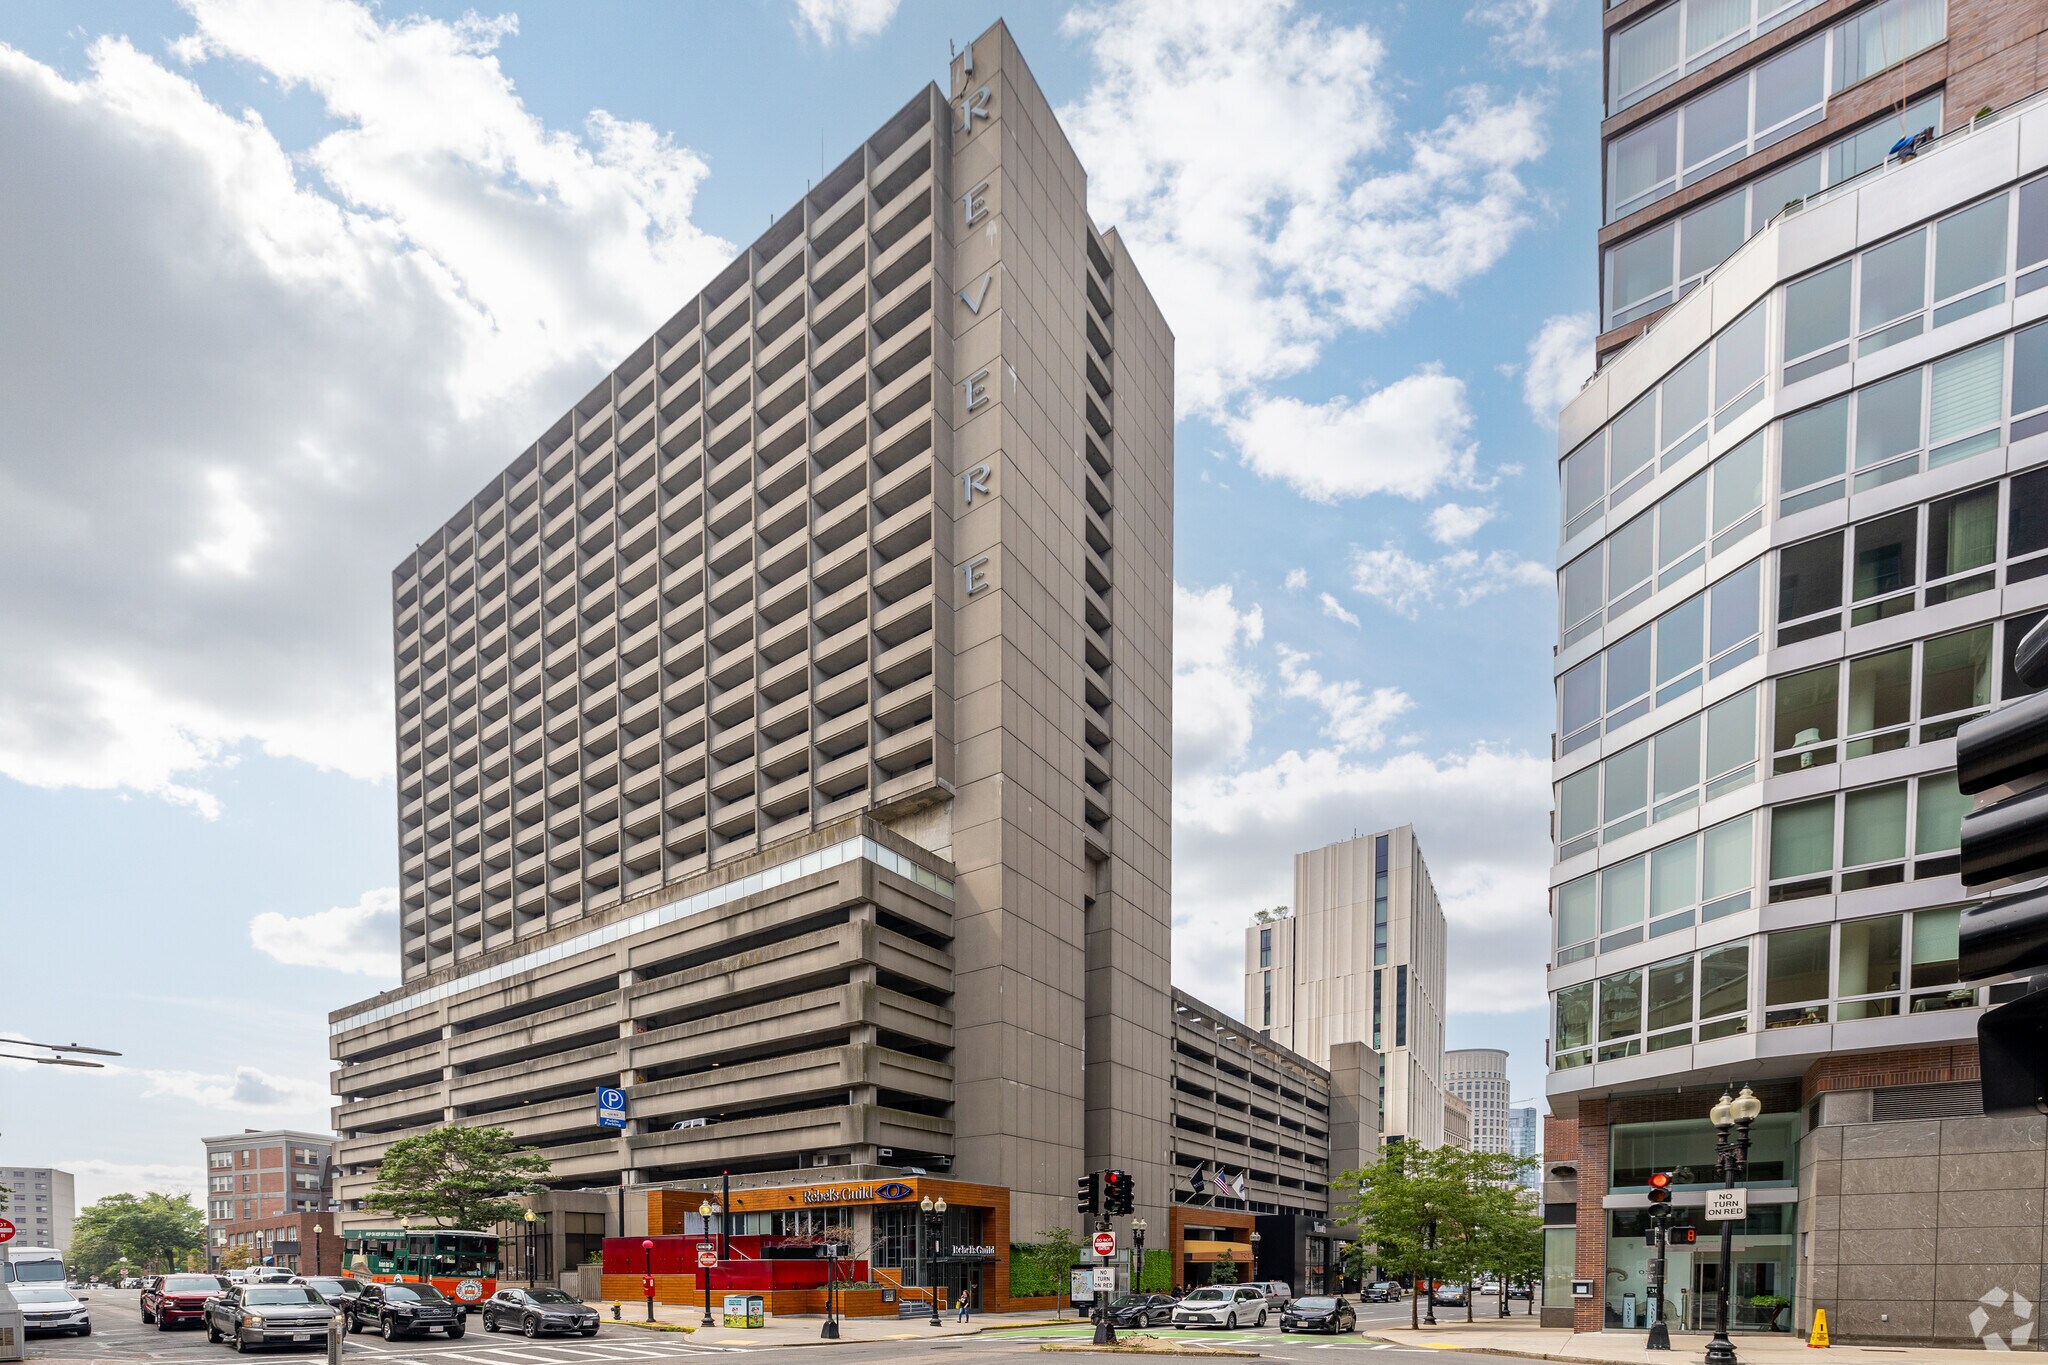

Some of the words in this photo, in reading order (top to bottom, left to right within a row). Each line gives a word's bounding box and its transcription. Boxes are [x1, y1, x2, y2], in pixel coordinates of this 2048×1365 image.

[961, 85, 992, 596] REVERE
[608, 1091, 619, 1106] P
[803, 1188, 839, 1203] Rebel's
[841, 1185, 873, 1200] Guild
[1687, 1229, 1695, 1241] 8
